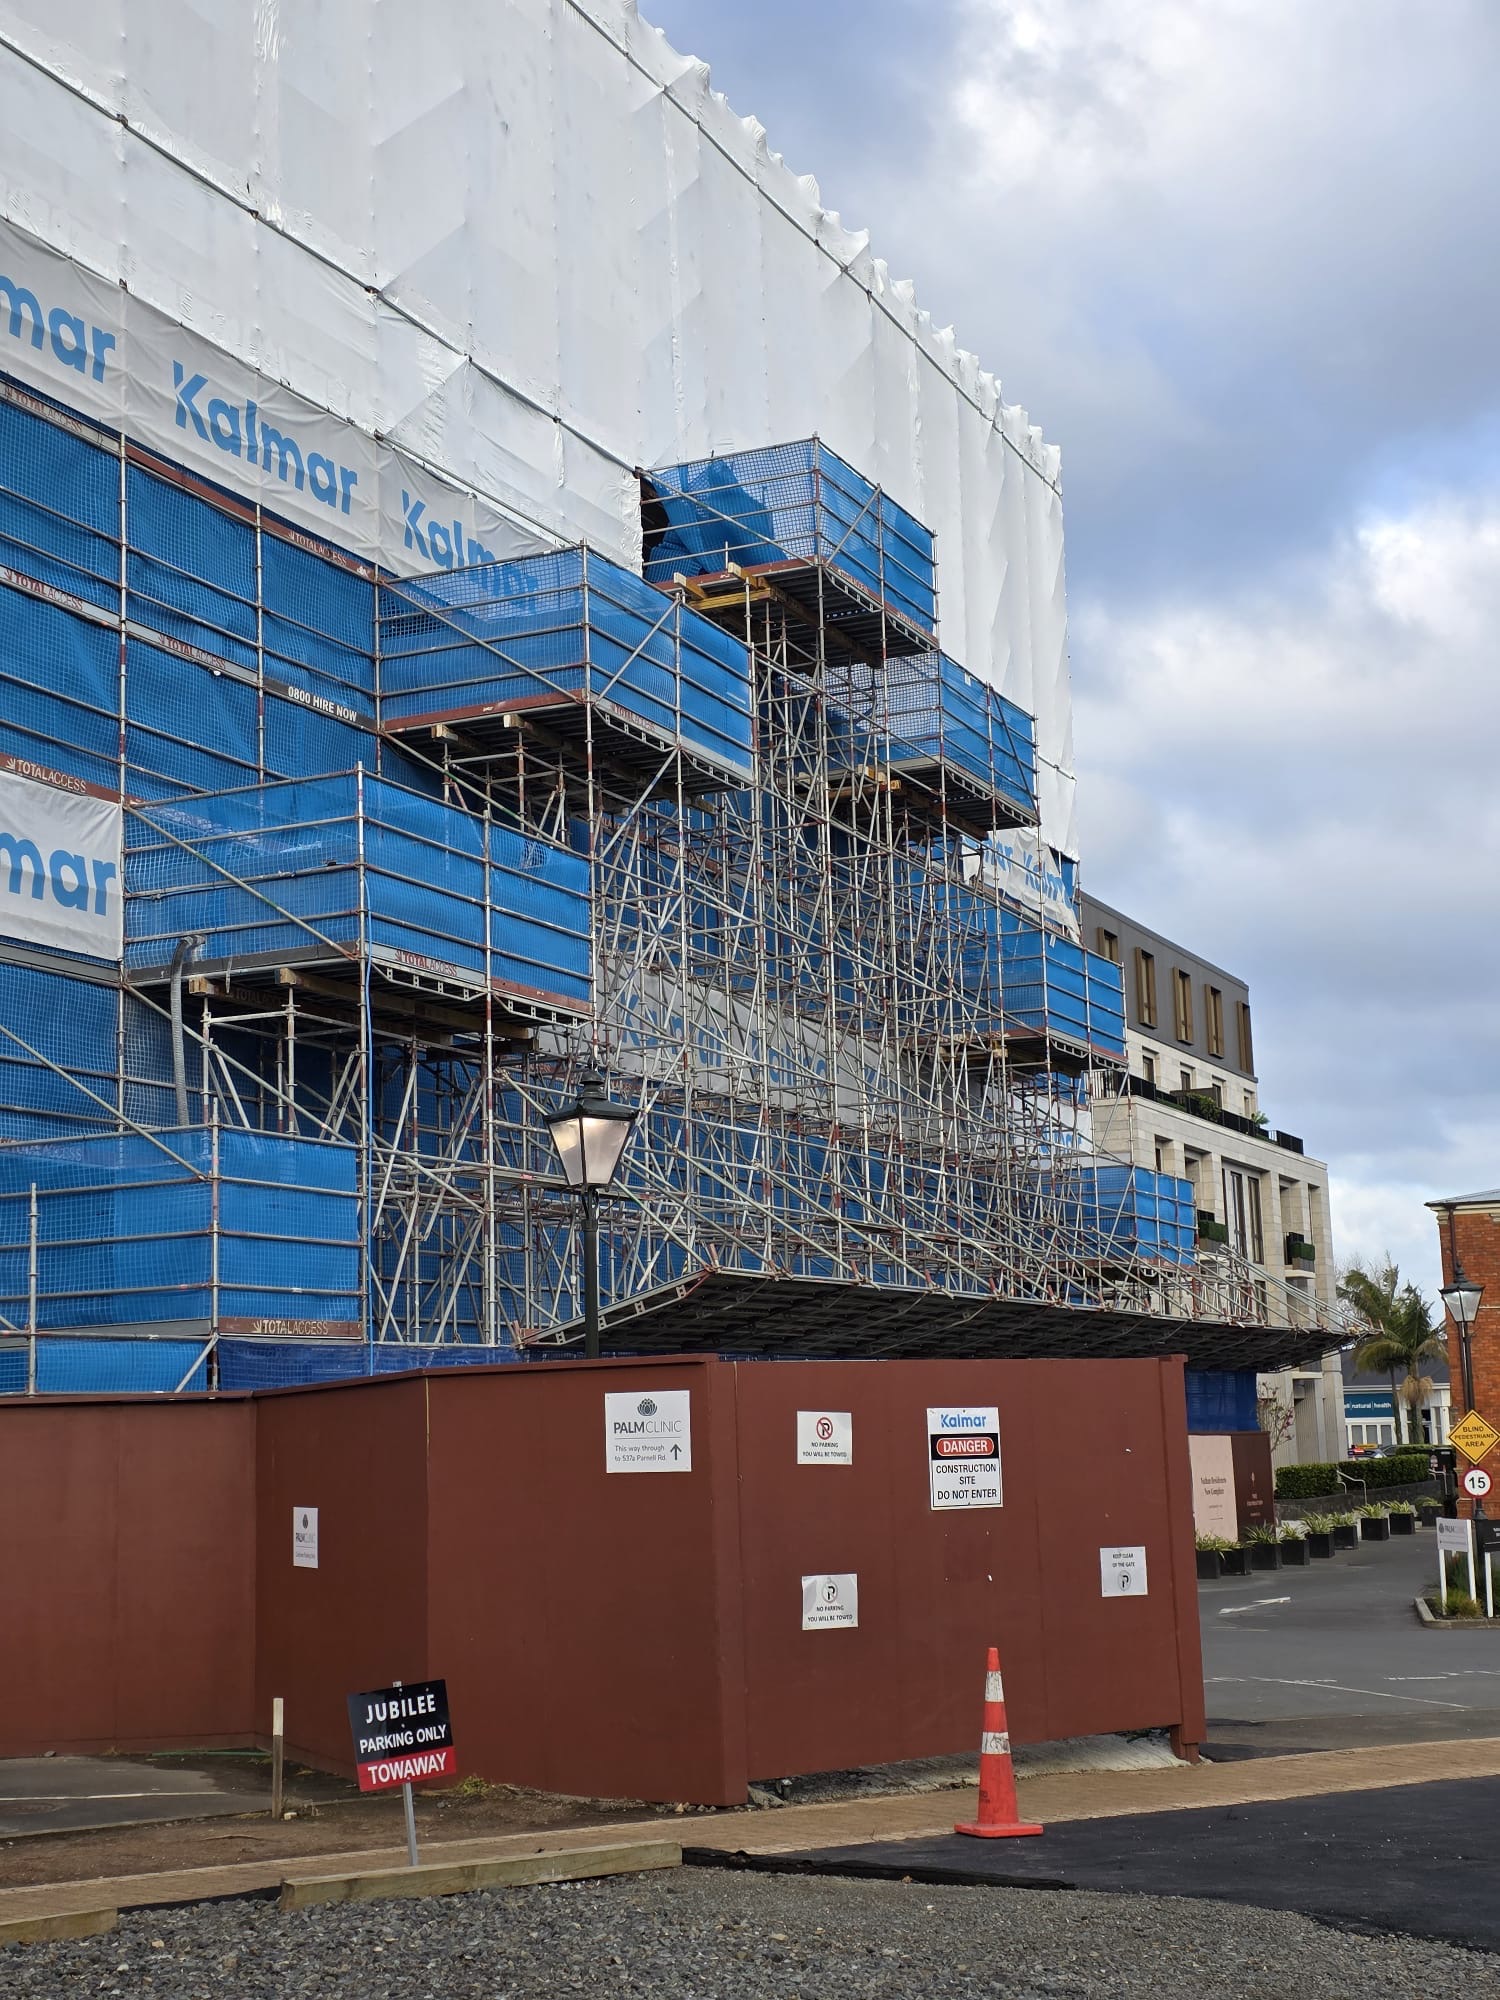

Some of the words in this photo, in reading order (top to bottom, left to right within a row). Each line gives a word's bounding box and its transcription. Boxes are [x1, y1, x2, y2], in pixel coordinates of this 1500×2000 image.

[172, 359, 358, 515] Kalmar
[288, 685, 311, 705] 0800
[313, 695, 335, 714] HIRE
[336, 705, 358, 722] NOW
[941, 1413, 986, 1428] Kalmar
[943, 1440, 988, 1453] DANGER
[936, 1463, 996, 1474] CONSTRUCTION
[959, 1475, 976, 1485] SITE
[1468, 1476, 1486, 1489] 15
[937, 1490, 950, 1500] DO
[952, 1489, 969, 1500] NOT
[971, 1488, 997, 1499] ENTER
[366, 1694, 436, 1724] JUBILEE
[360, 1731, 414, 1754] PARKING
[416, 1724, 447, 1743] ONLY
[368, 1752, 447, 1785] TOWAWAY
